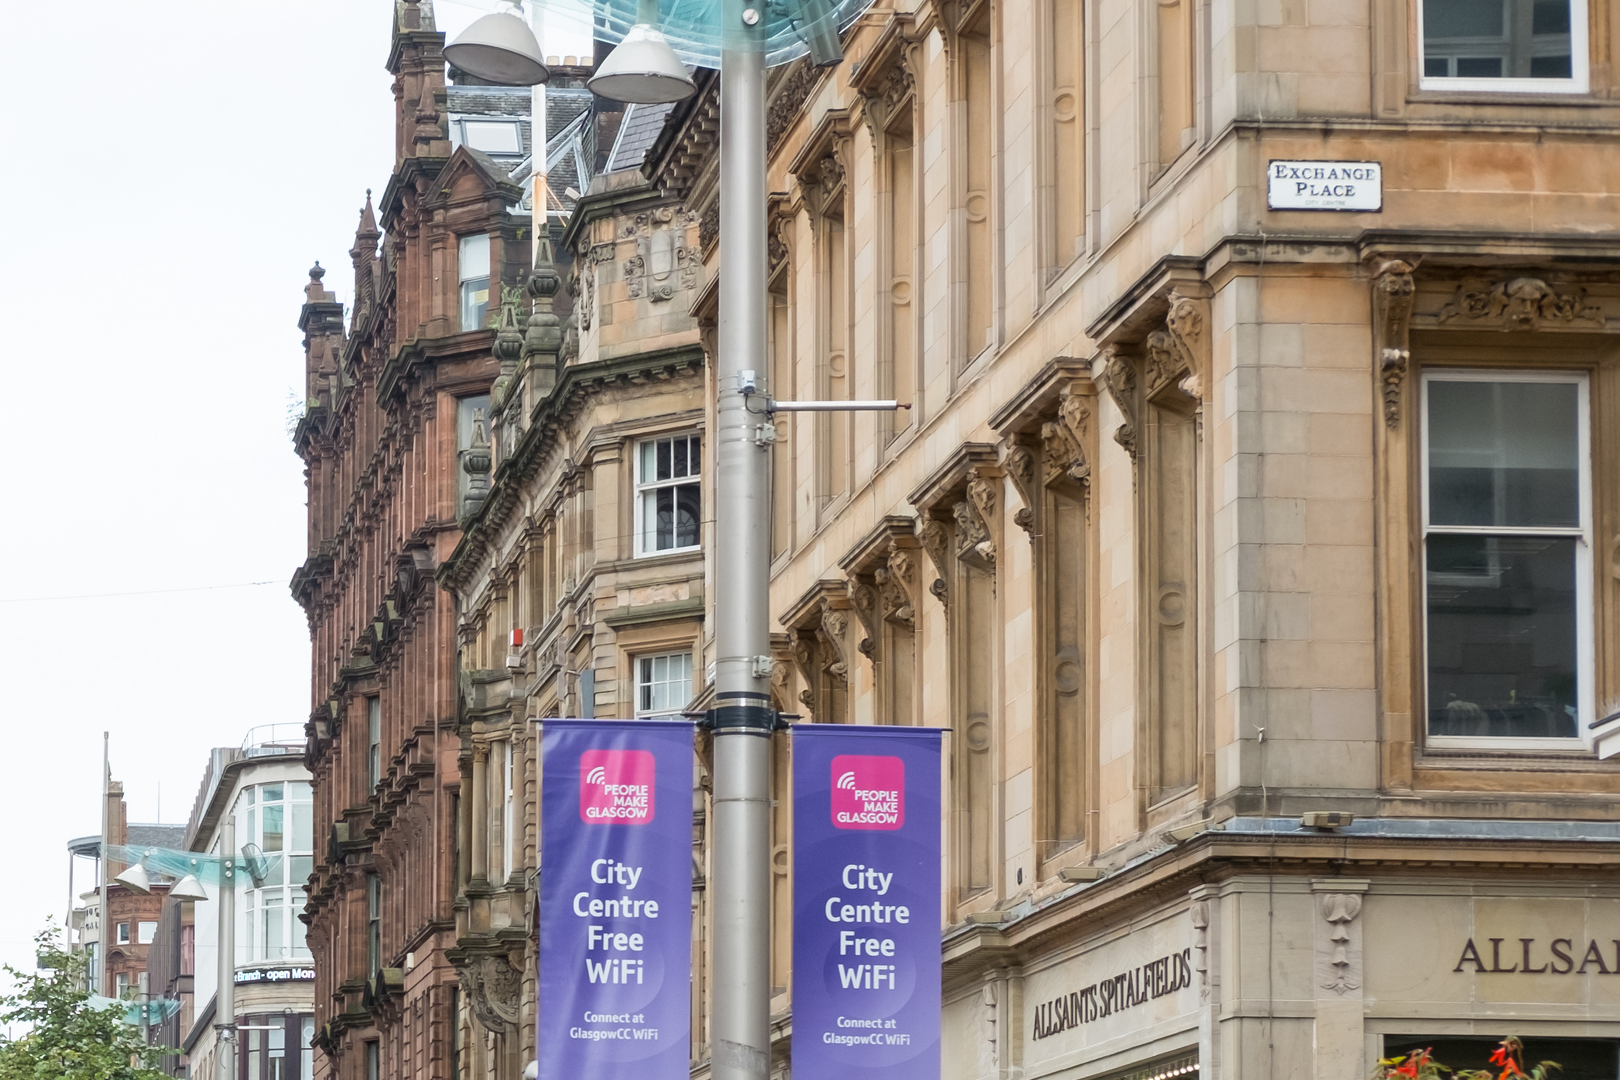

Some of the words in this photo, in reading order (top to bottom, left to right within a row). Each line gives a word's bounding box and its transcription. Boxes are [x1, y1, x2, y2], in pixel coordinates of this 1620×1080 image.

[1274, 165, 1376, 180] EXCHANGE
[1295, 182, 1356, 196] PLACE
[604, 784, 648, 796] PEOPLE
[854, 790, 898, 801] PEOPLE
[614, 796, 648, 807] MAKE
[864, 802, 898, 813] MAKE
[586, 807, 648, 818] GLASGOW
[837, 812, 898, 823] GLASGOW
[591, 859, 642, 890] City
[842, 864, 893, 895] City
[573, 892, 659, 918] Centre
[825, 897, 910, 924] Centre
[588, 925, 644, 951] Free
[840, 931, 895, 956] Free
[266, 970, 291, 982] open
[585, 958, 644, 984] WiFi
[837, 964, 895, 990] WiFi
[1032, 983, 1098, 1041] ALLSAINTS
[1099, 947, 1192, 1018] SPITALFIELDS
[584, 1011, 630, 1023] Connect
[632, 1013, 645, 1023] at
[837, 1016, 883, 1028] Connect
[884, 1019, 897, 1029] at
[569, 1027, 631, 1041] GlasgowCC
[633, 1028, 658, 1040] WiFi
[823, 1032, 883, 1046] GlasgowCC
[885, 1034, 910, 1045] WiFi
